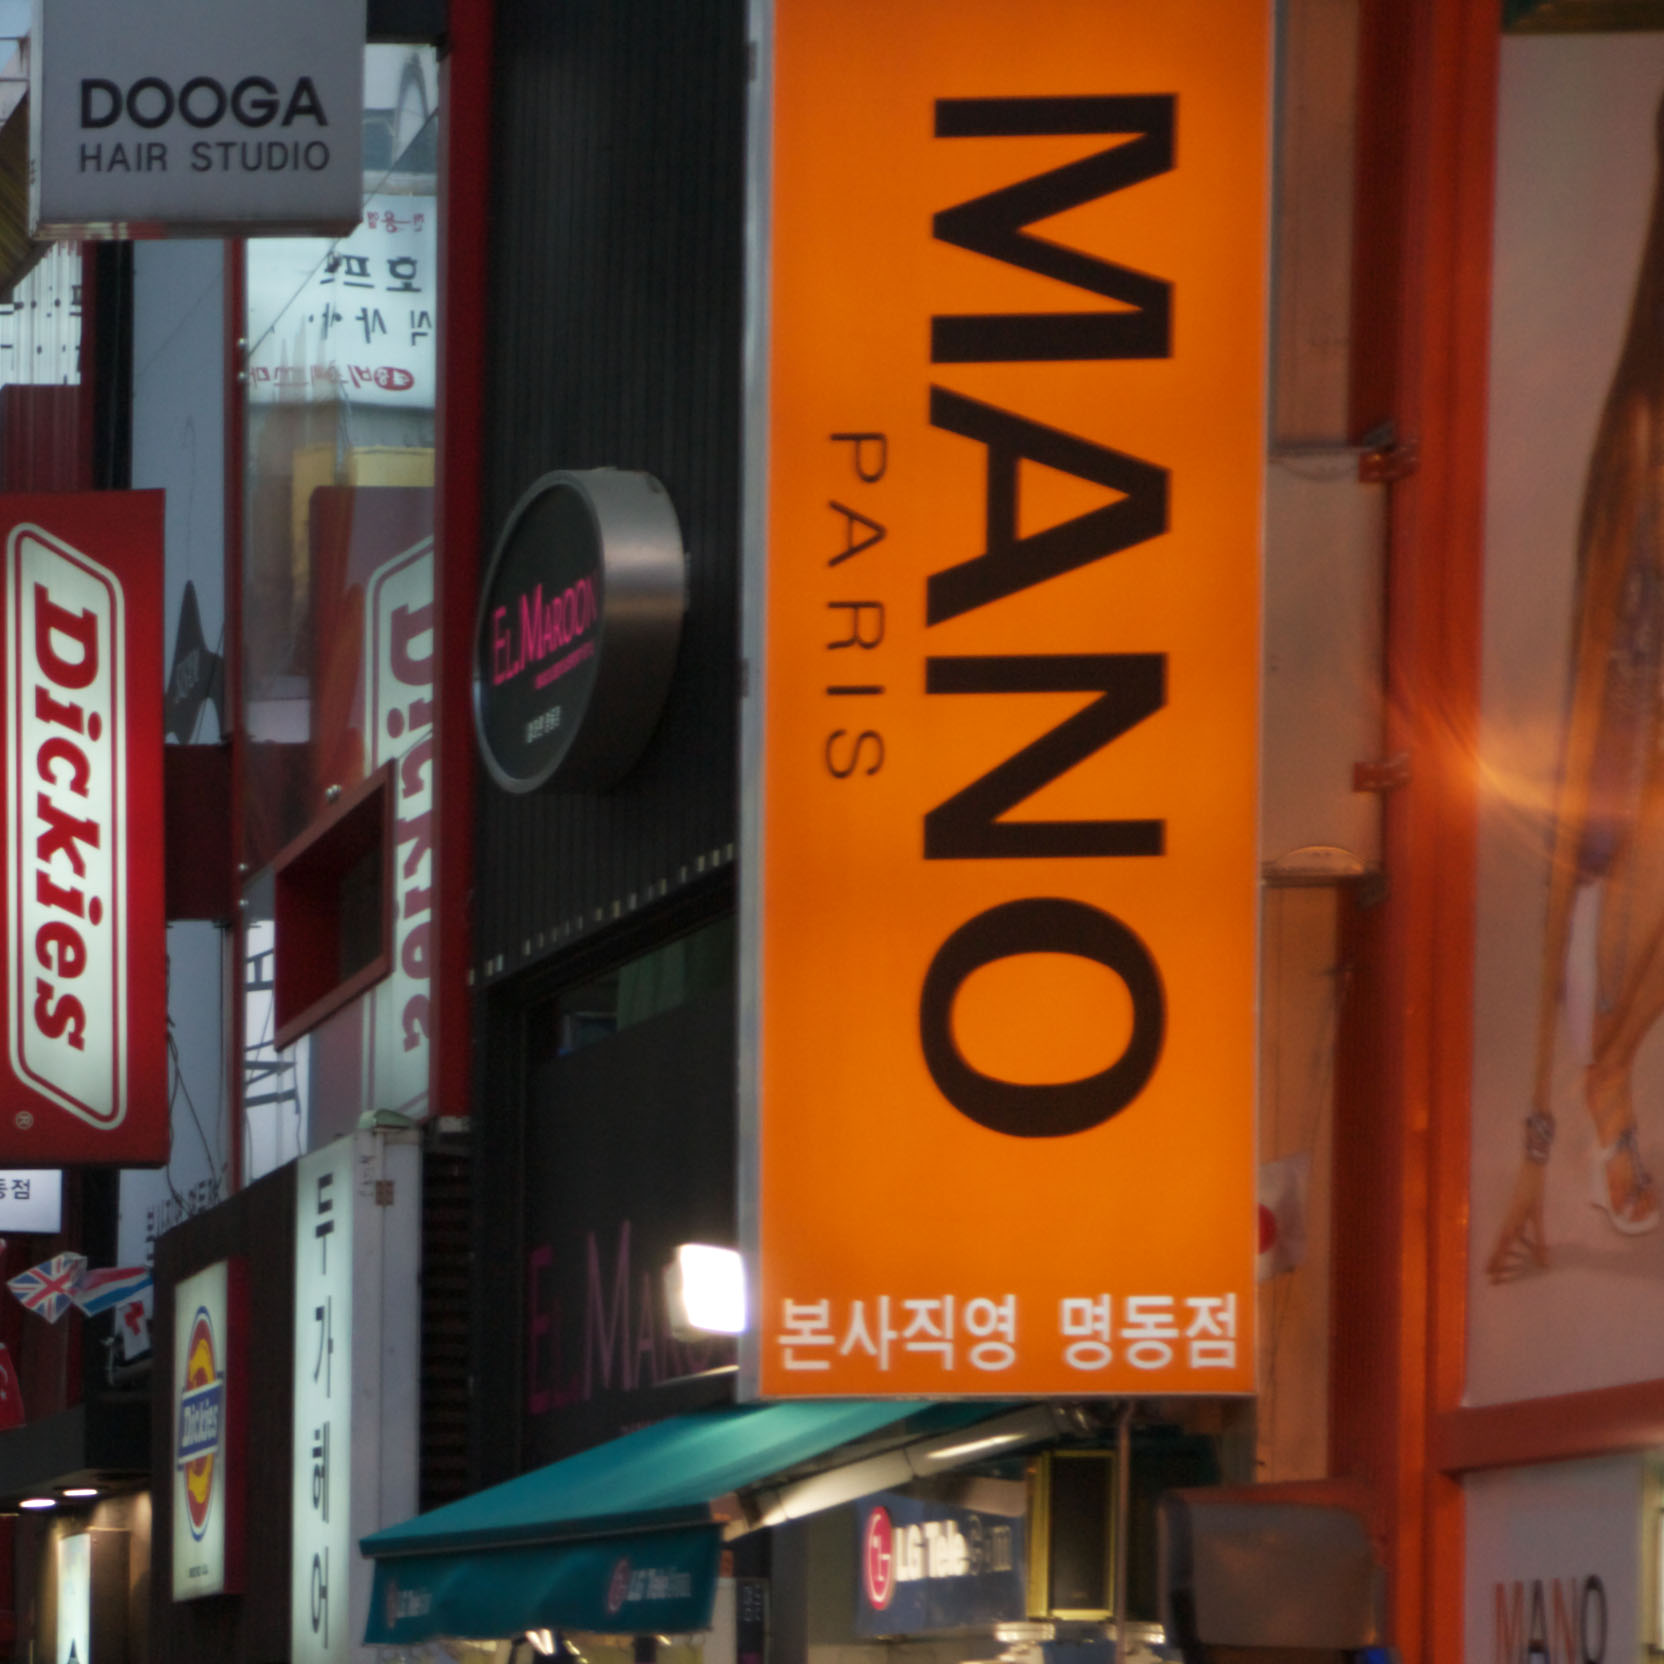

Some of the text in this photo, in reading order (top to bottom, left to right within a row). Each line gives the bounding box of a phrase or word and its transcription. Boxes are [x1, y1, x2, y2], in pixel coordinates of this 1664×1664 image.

[80, 77, 328, 128] DOOGA
[79, 140, 330, 173] HAIR STUDIO
[825, 431, 890, 781] PARIS
[919, 93, 1180, 1138] MANO
[34, 581, 105, 1052] Dickies
[777, 1292, 1018, 1373] 본사직영
[1059, 1291, 1240, 1371] 명동점
[182, 1402, 219, 1449] Dickies
[897, 1524, 922, 1581] LG
